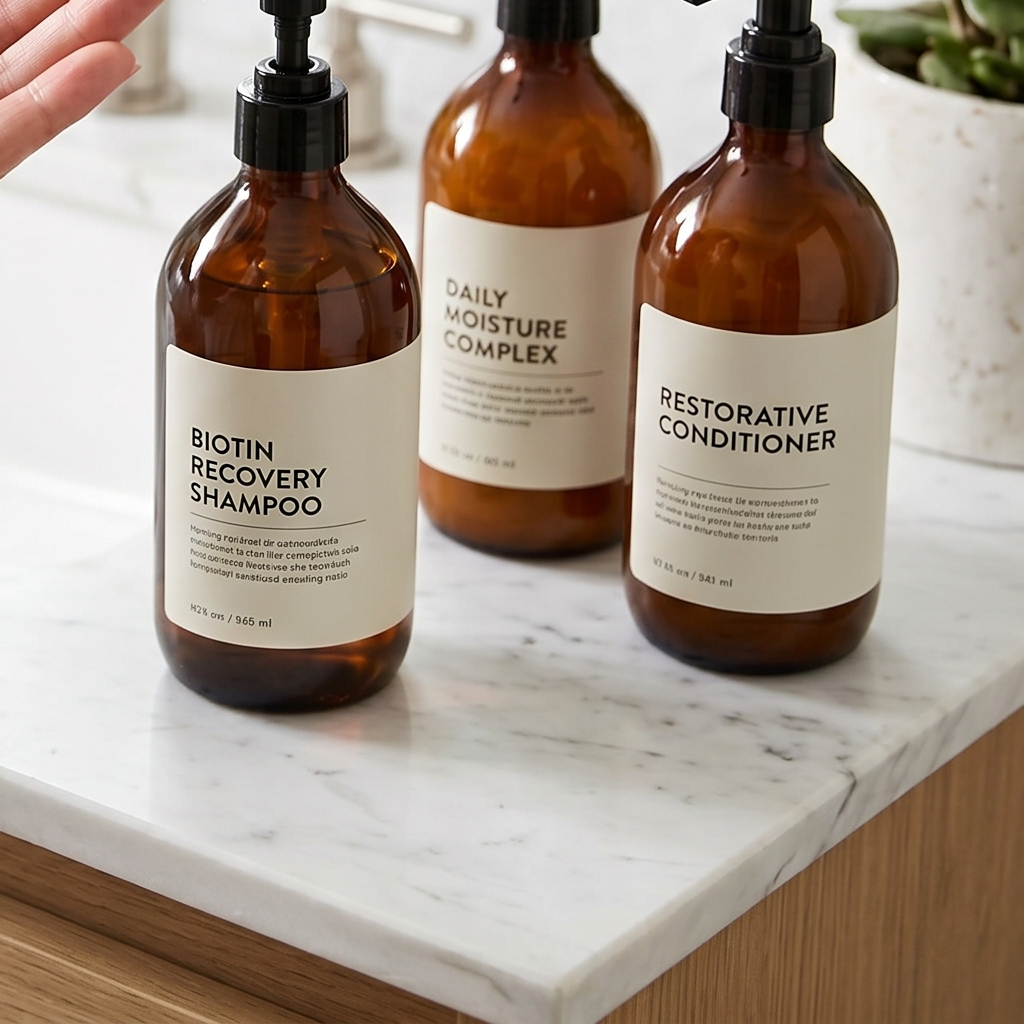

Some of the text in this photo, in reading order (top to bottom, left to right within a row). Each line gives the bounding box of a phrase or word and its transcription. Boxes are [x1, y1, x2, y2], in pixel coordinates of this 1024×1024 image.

[446, 278, 508, 309] DAILY
[445, 306, 567, 339] MOISTURE
[444, 330, 557, 365] COMPLEX
[660, 386, 829, 426] RESTORATIVE
[192, 427, 273, 462] BIOTIN
[659, 415, 836, 453] CONDITIONER
[192, 455, 327, 489] RECOVERY
[191, 482, 322, 516] SHAMPOO
[289, 563, 307, 572] she
[719, 578, 733, 588] ml
[235, 615, 255, 626] 965
[258, 618, 272, 628] ml
